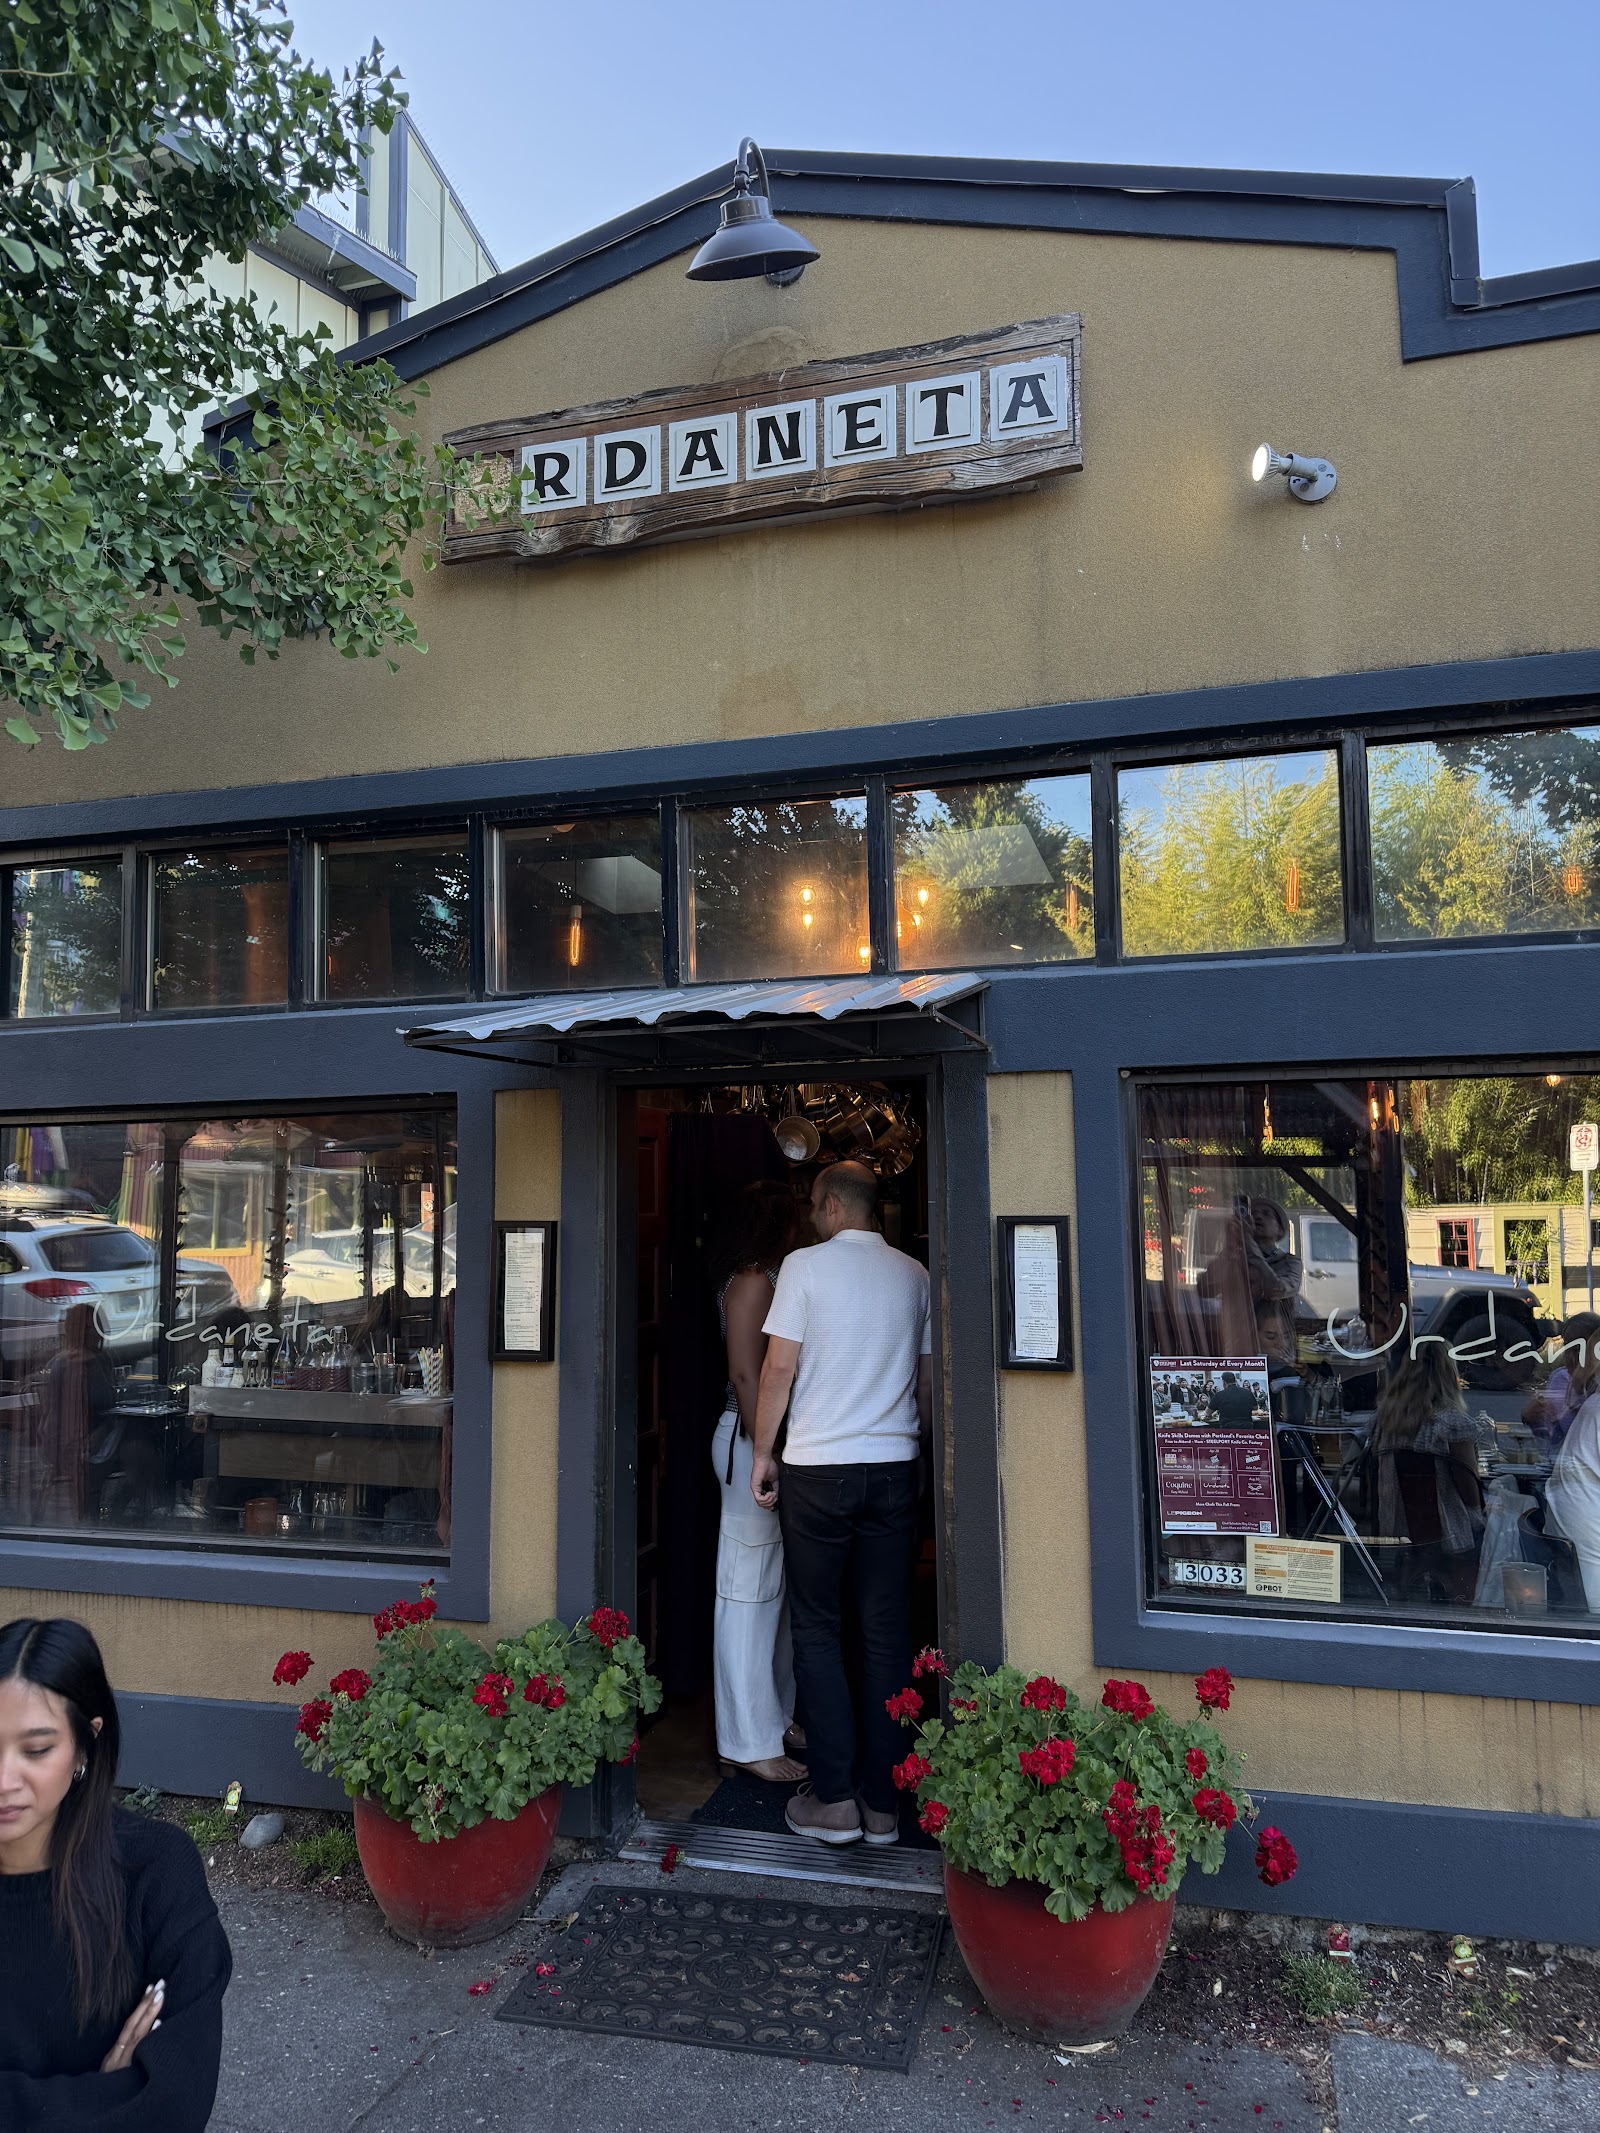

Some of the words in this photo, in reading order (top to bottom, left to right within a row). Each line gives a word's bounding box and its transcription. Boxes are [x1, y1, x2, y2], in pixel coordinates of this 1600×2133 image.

[93, 1286, 334, 1346] Urdaneta
[1327, 1289, 1600, 1367] Urdan
[1193, 1360, 1218, 1368] Saturday
[1227, 1360, 1243, 1368] Every
[1165, 1481, 1193, 1490] Coquine
[1185, 1564, 1243, 1584] 3033
[1263, 1584, 1282, 1592] PBOT
